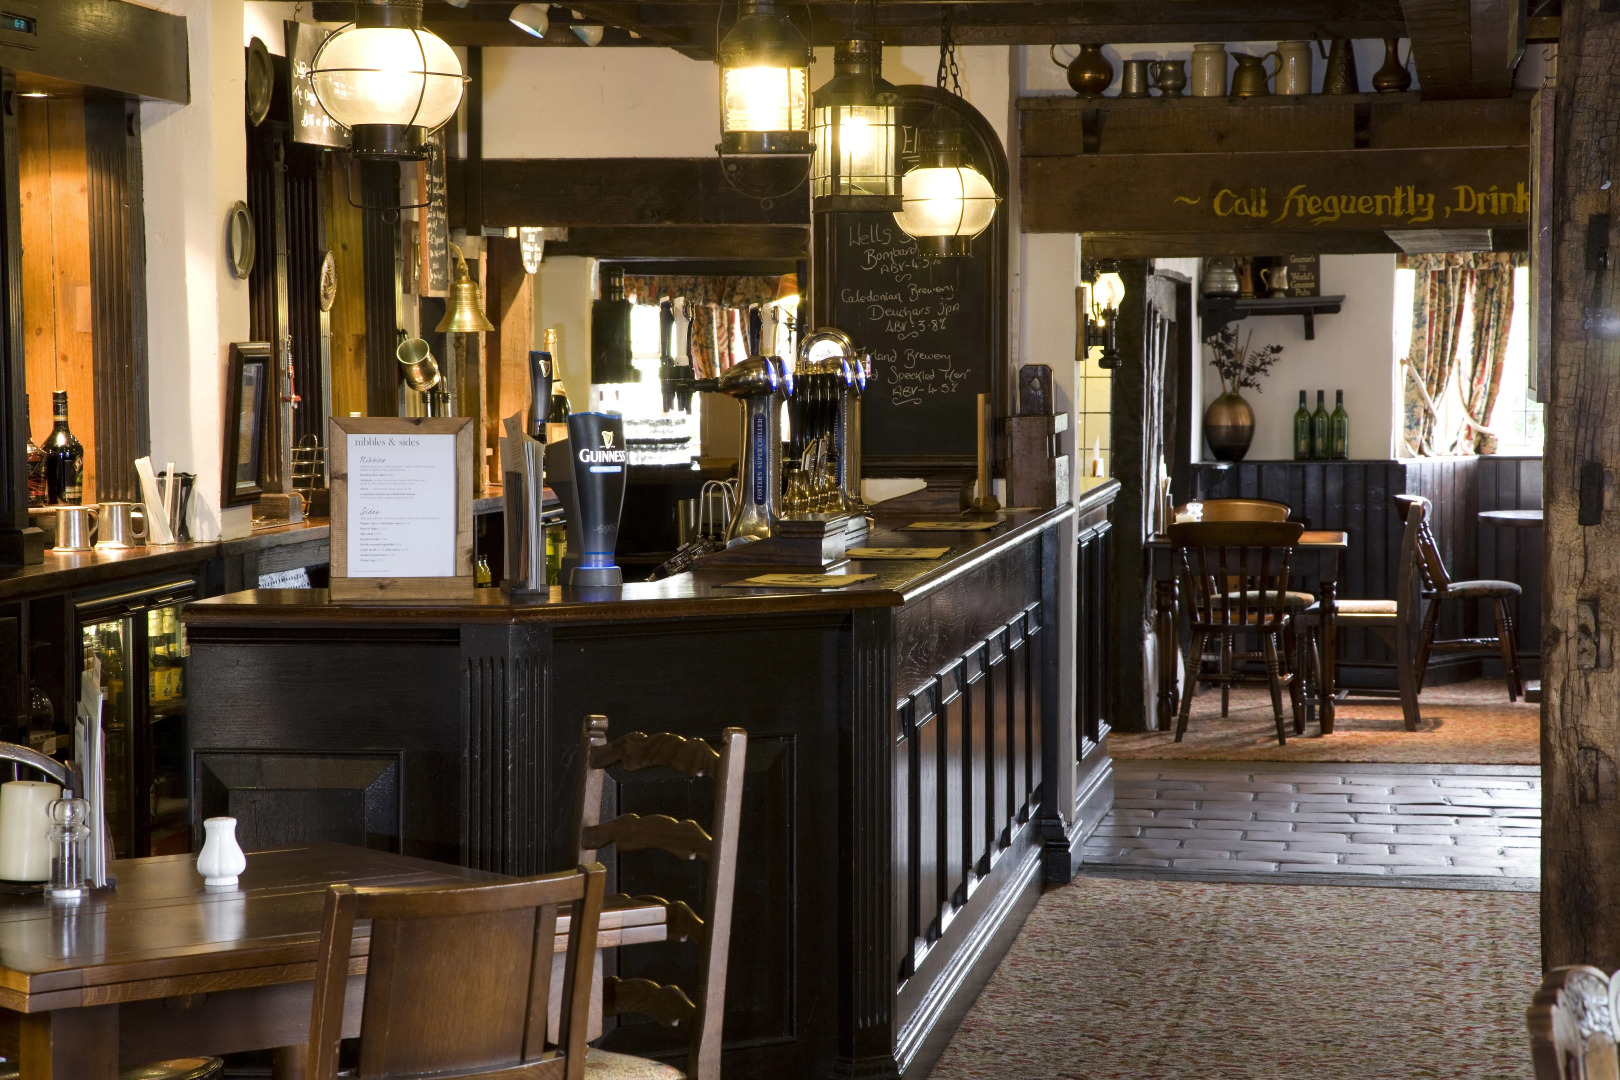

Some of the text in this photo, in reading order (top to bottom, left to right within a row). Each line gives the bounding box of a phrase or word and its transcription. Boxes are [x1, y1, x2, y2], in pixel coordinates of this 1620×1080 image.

[1213, 186, 1269, 218] Call
[849, 221, 893, 247] Wells
[861, 242, 918, 270] Bombard
[1290, 272, 1315, 280] World's
[841, 283, 954, 303] Caledonian Brewery
[904, 348, 952, 372] Brewery
[354, 437, 420, 447] nibbles & sides
[359, 455, 387, 464] Nibbles
[579, 448, 626, 463] GUINNESS
[359, 506, 380, 516] Sides
